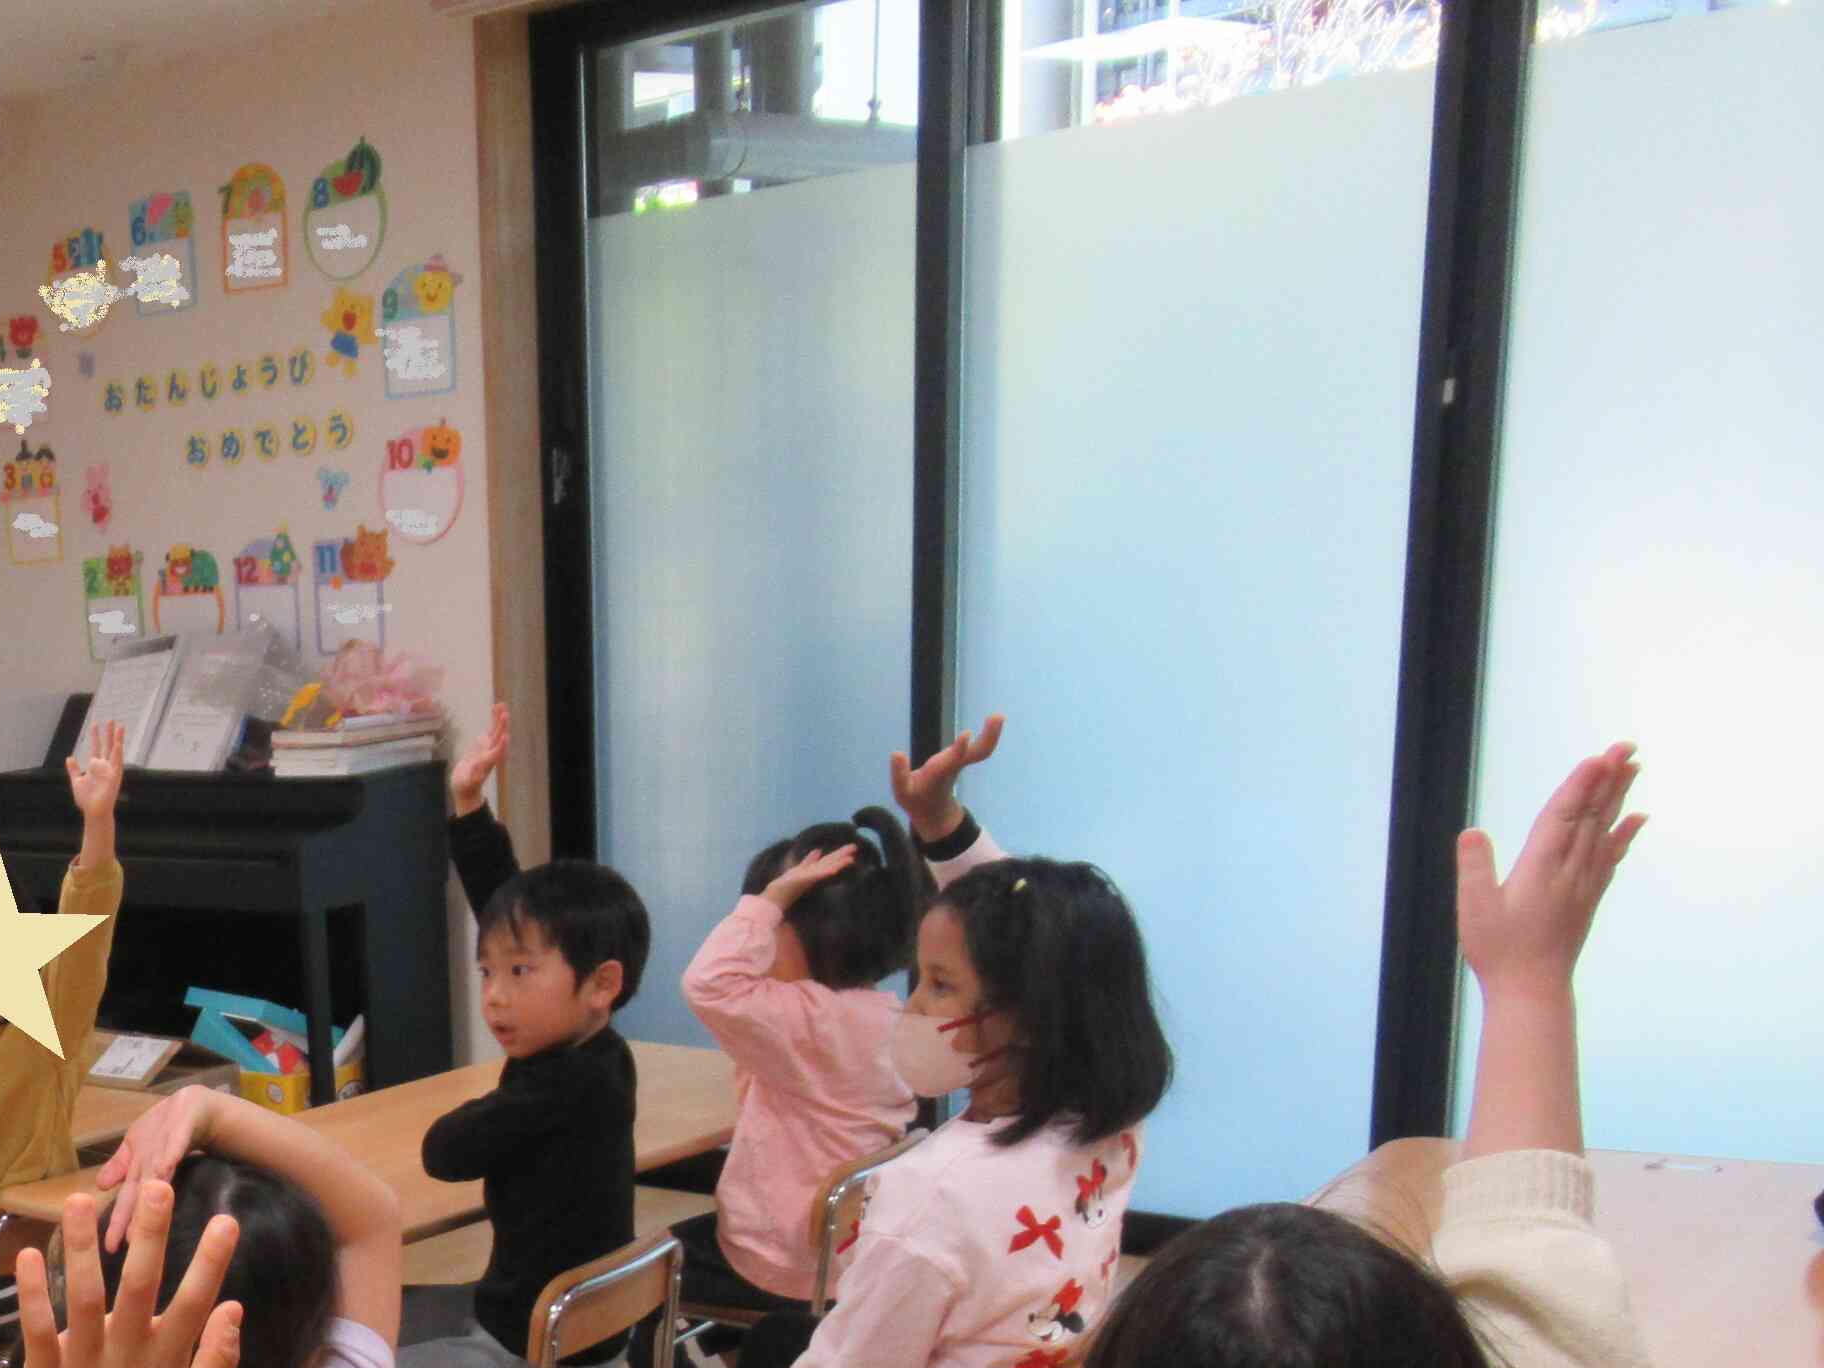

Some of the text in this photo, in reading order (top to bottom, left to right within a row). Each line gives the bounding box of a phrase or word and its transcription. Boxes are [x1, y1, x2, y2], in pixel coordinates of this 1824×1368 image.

[103, 350, 314, 412] おたんじょうび
[186, 414, 348, 465] おめでとう
[387, 438, 414, 471] 10
[234, 556, 259, 584] 12
[317, 544, 339, 574] 11
